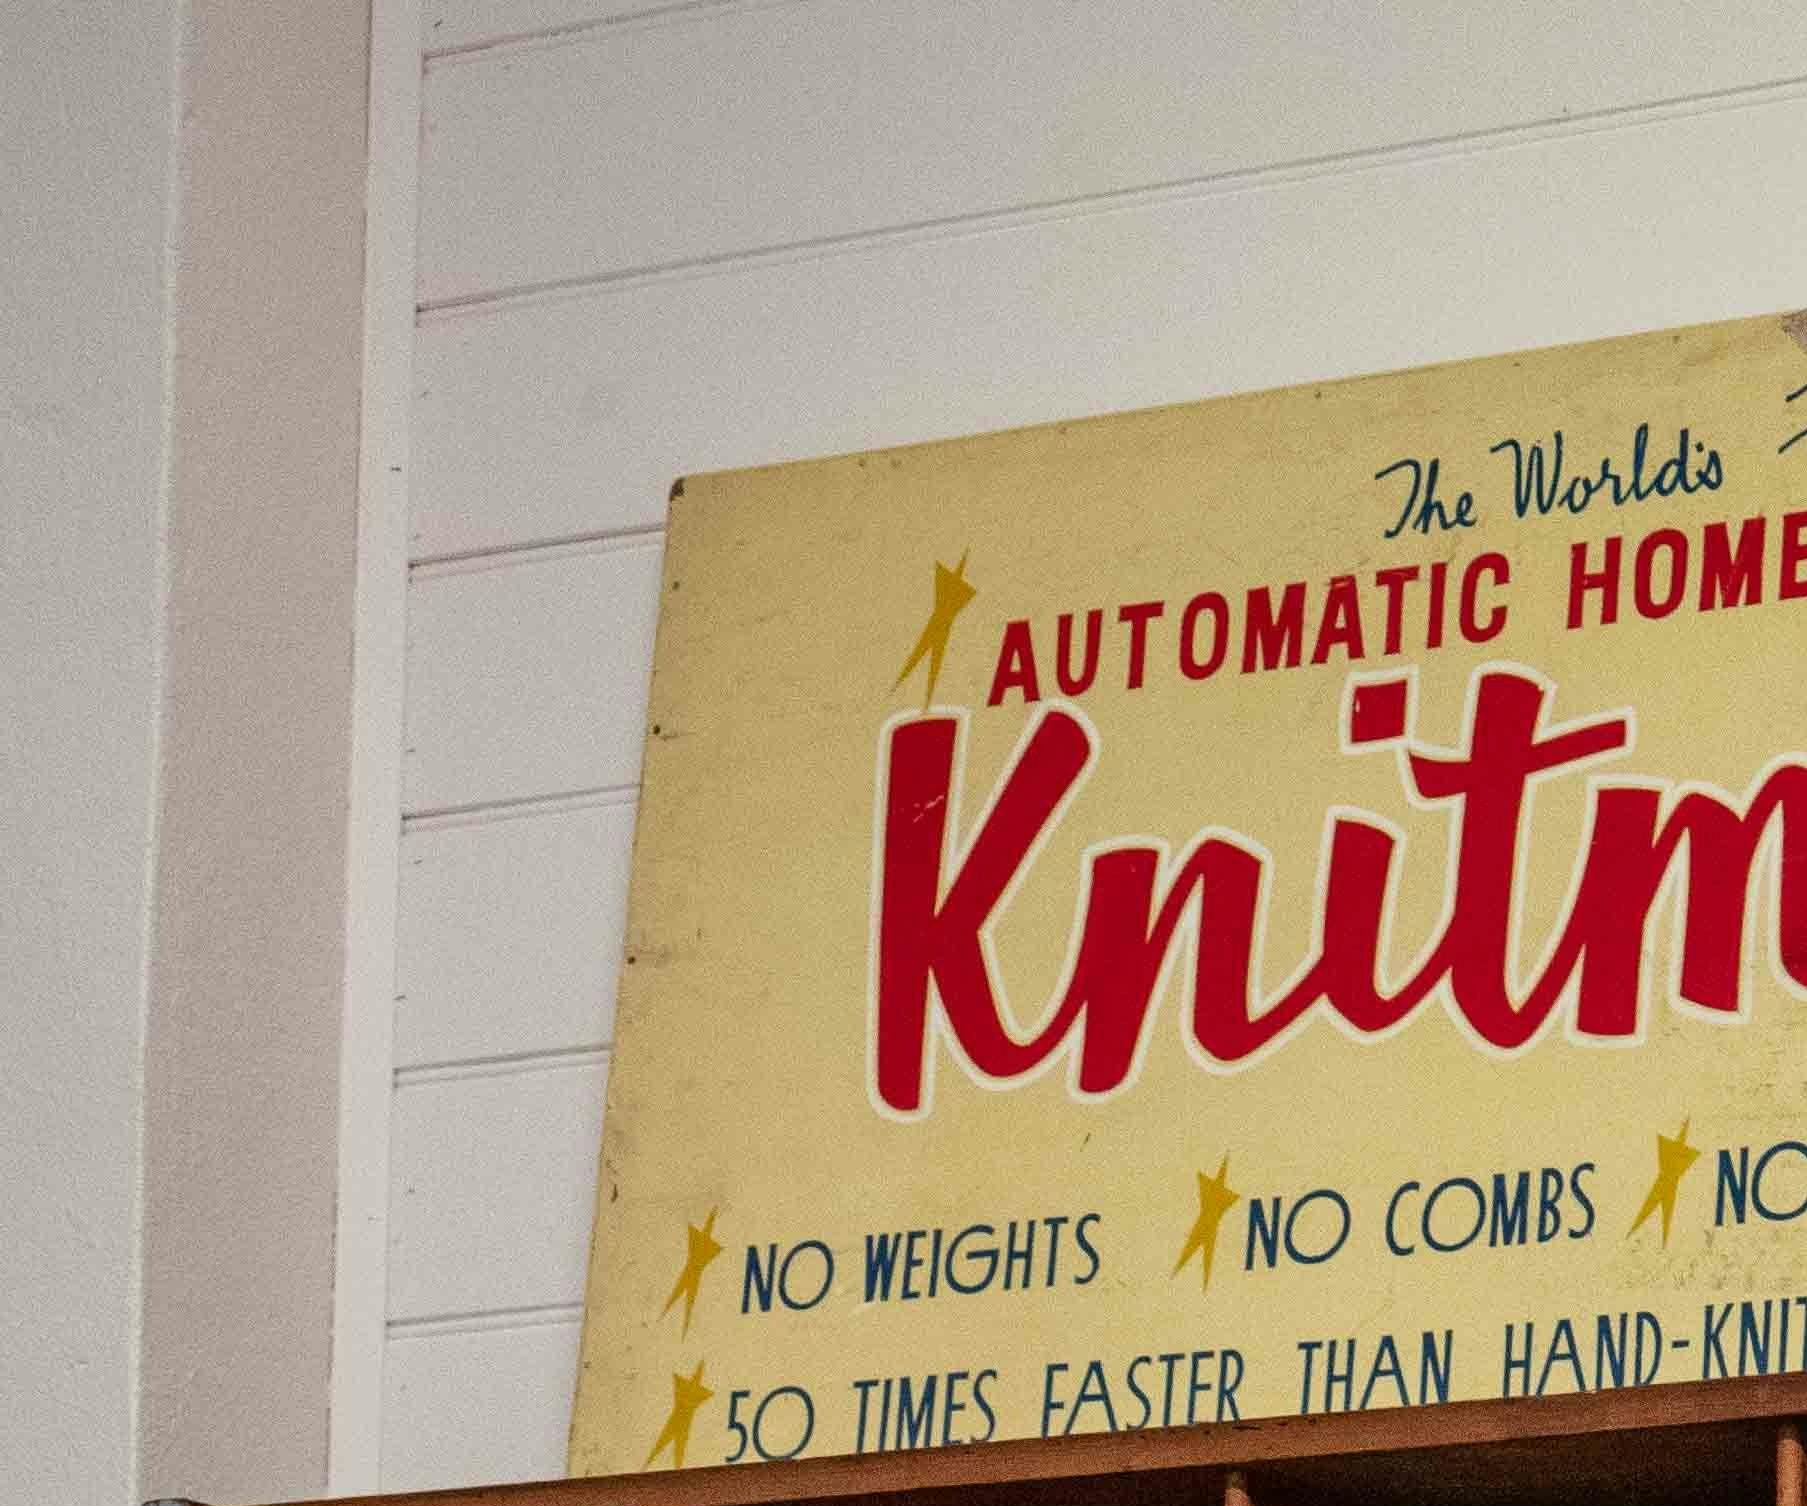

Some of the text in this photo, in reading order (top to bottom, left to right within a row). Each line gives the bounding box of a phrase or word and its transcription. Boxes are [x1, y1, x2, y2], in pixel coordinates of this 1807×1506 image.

[1374, 457, 1478, 540] The
[986, 550, 1512, 706] AUTOMATIC
[740, 1238, 836, 1315] NO
[863, 1212, 1102, 1304] WEIGHTS
[1244, 1188, 1352, 1272] NO
[1384, 1161, 1596, 1258] COMBS
[724, 1385, 816, 1463] 50
[852, 1368, 999, 1456] TIMES
[1040, 1347, 1246, 1440] FASTER
[1297, 1328, 1454, 1415] THAN
